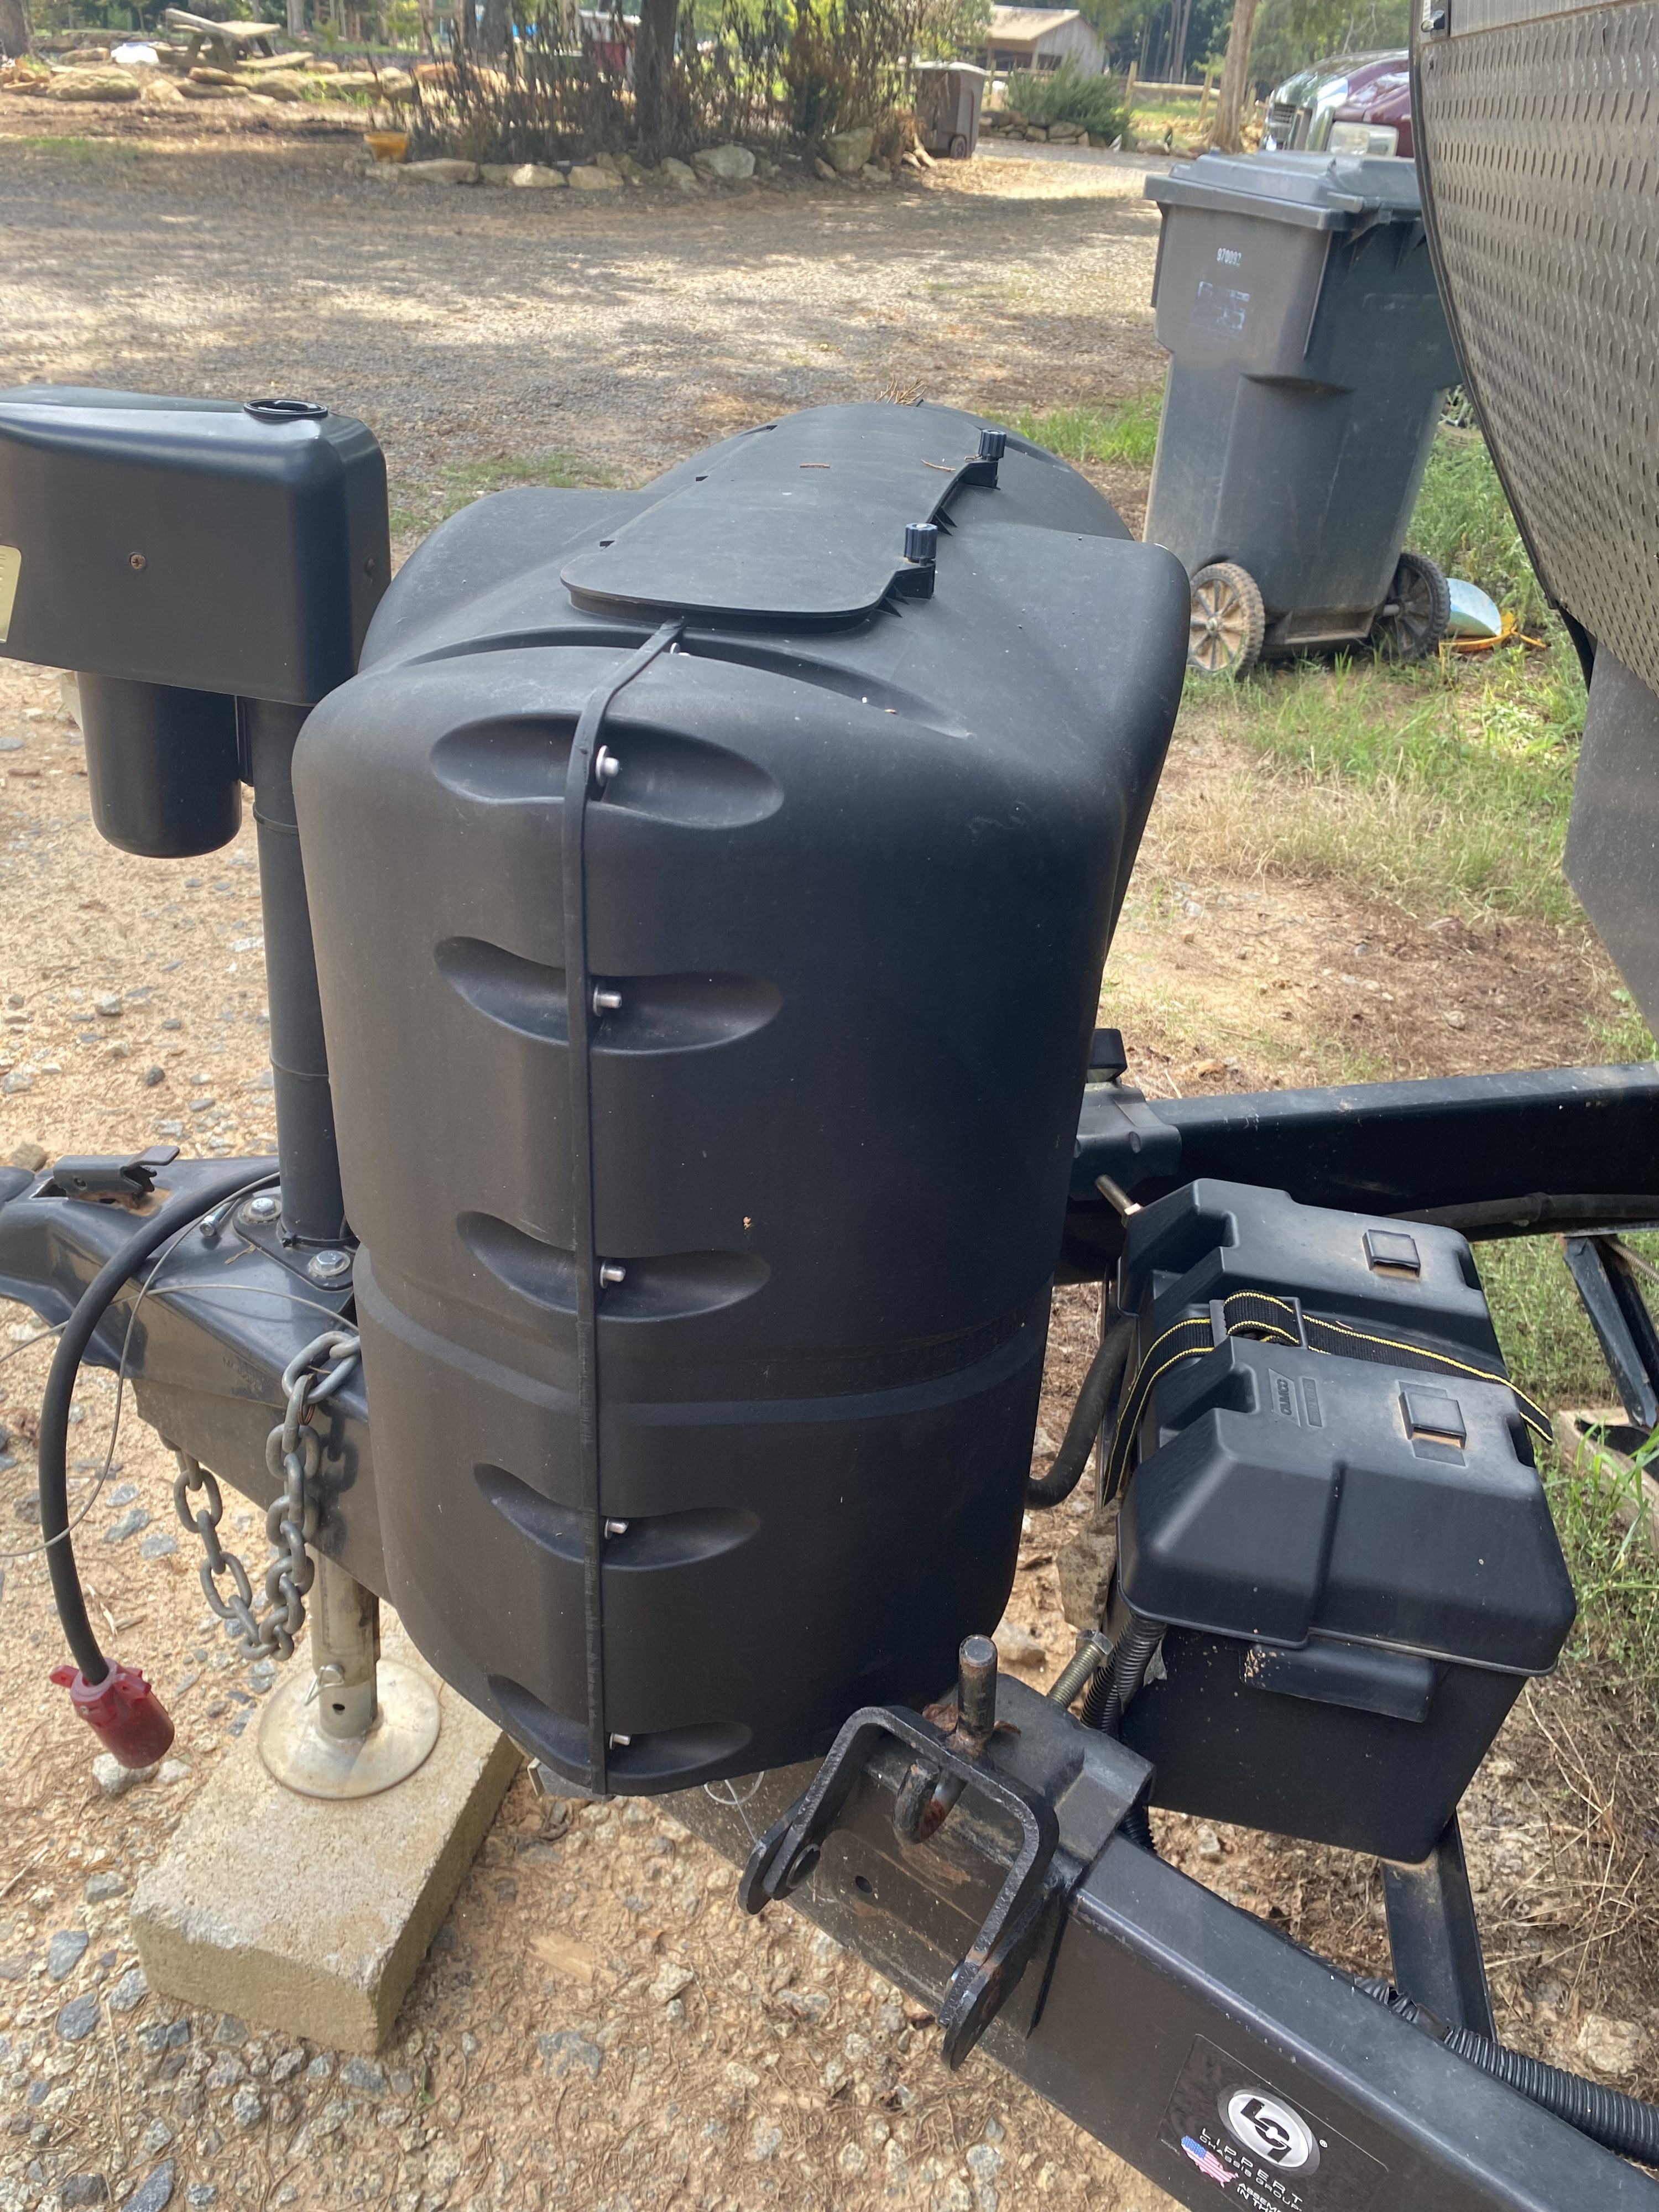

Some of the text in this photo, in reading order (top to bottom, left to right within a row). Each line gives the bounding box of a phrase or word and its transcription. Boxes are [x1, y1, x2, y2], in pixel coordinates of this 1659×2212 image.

[1276, 1378, 1292, 1415] CAMCO
[1199, 2135, 1300, 2211] CHASSIS GROUP
[1201, 2128, 1303, 2203] LIPPERT
[1237, 2186, 1274, 2212] IN TH
[1238, 2183, 1282, 2212] ASSEM
